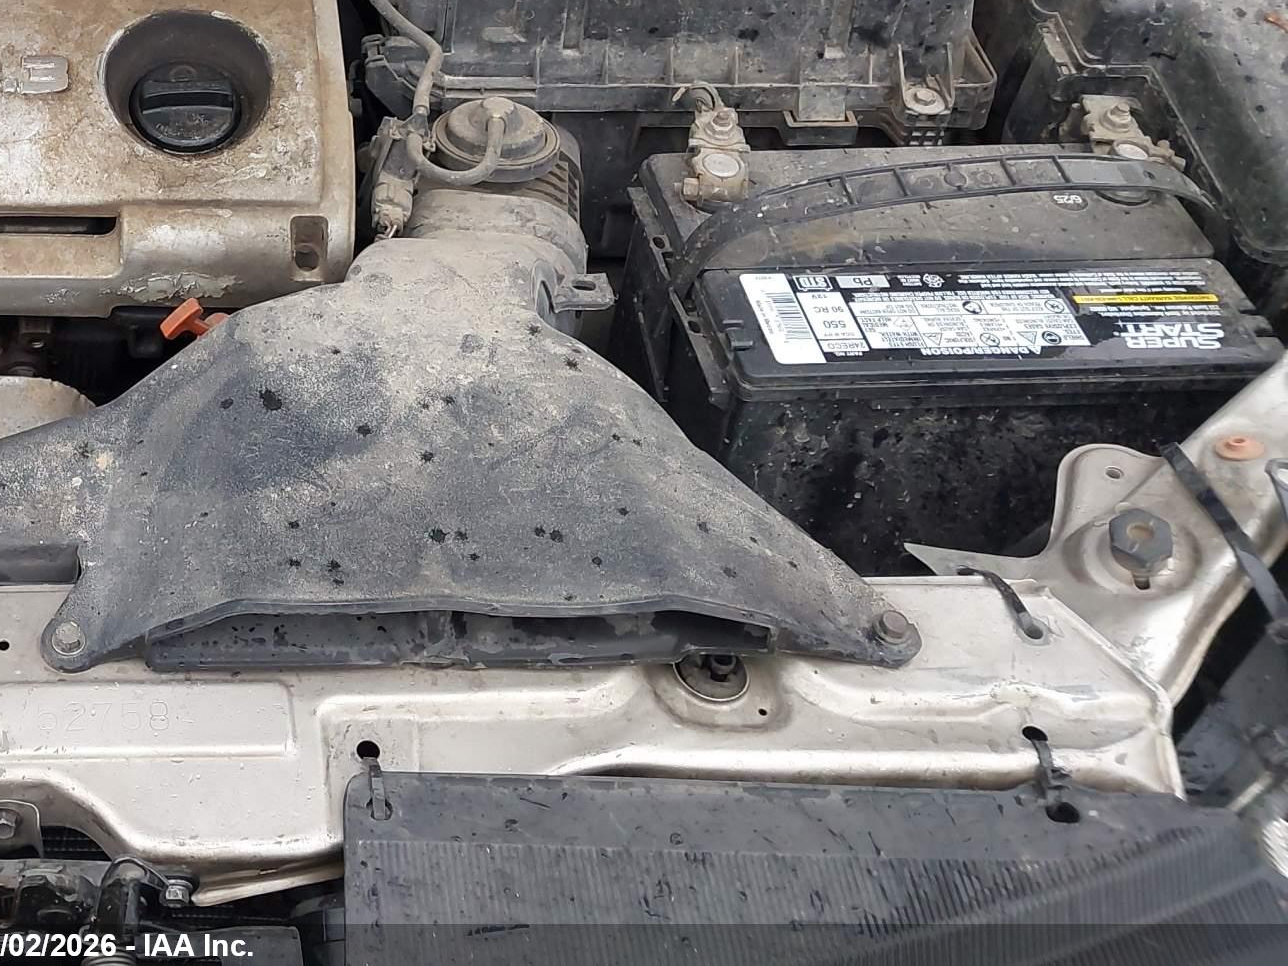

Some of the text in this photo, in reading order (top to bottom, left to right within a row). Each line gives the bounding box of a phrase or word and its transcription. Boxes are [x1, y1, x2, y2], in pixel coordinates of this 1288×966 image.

[852, 276, 872, 286] Pb
[813, 306, 829, 314] RC
[822, 320, 846, 329] 550
[1119, 323, 1224, 338] START
[1125, 336, 1222, 350] SUPER
[921, 345, 1030, 356] DANGER/POISON
[37, 699, 170, 732] 52758
